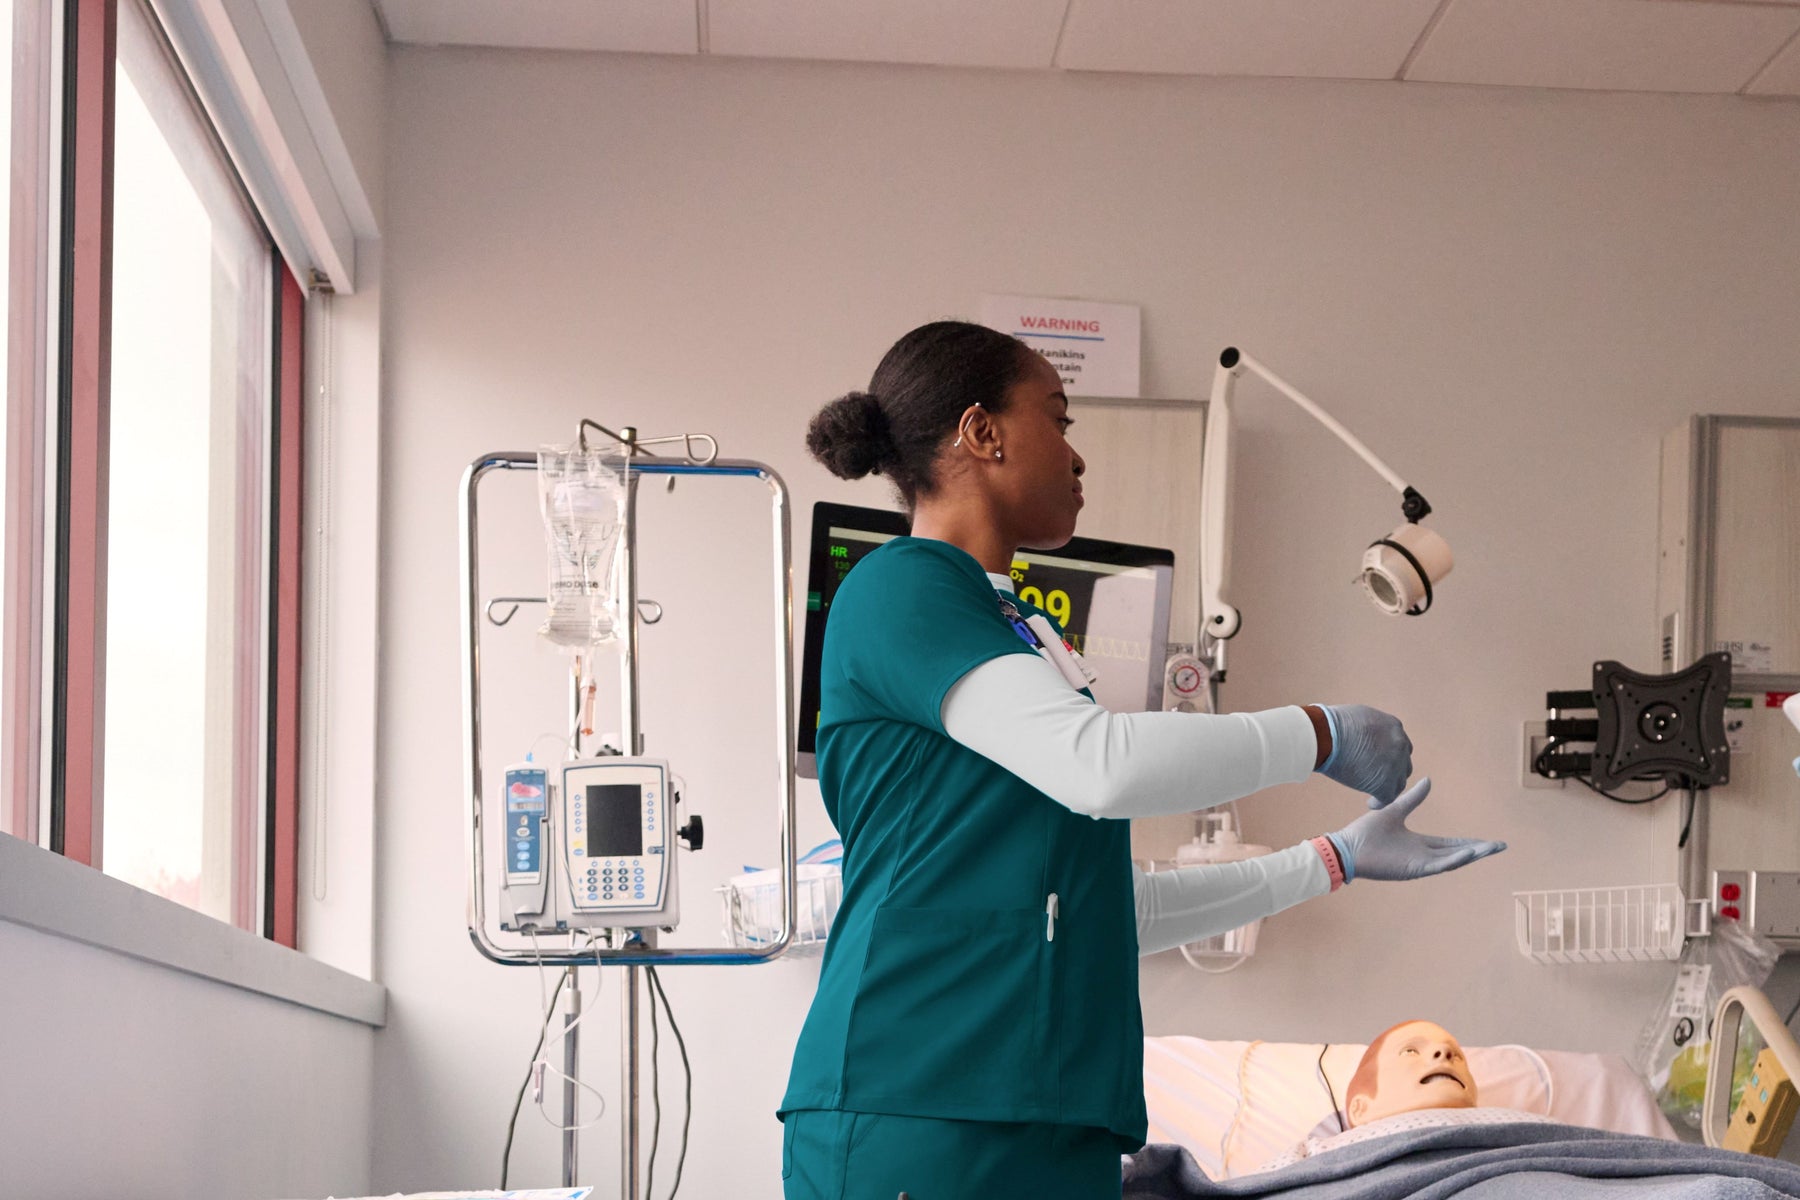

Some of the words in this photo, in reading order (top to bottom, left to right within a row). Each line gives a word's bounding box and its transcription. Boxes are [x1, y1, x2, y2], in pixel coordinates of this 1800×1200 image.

[1020, 315, 1100, 332] WARNING
[1054, 362, 1082, 372] ntain
[830, 545, 847, 557] HR
